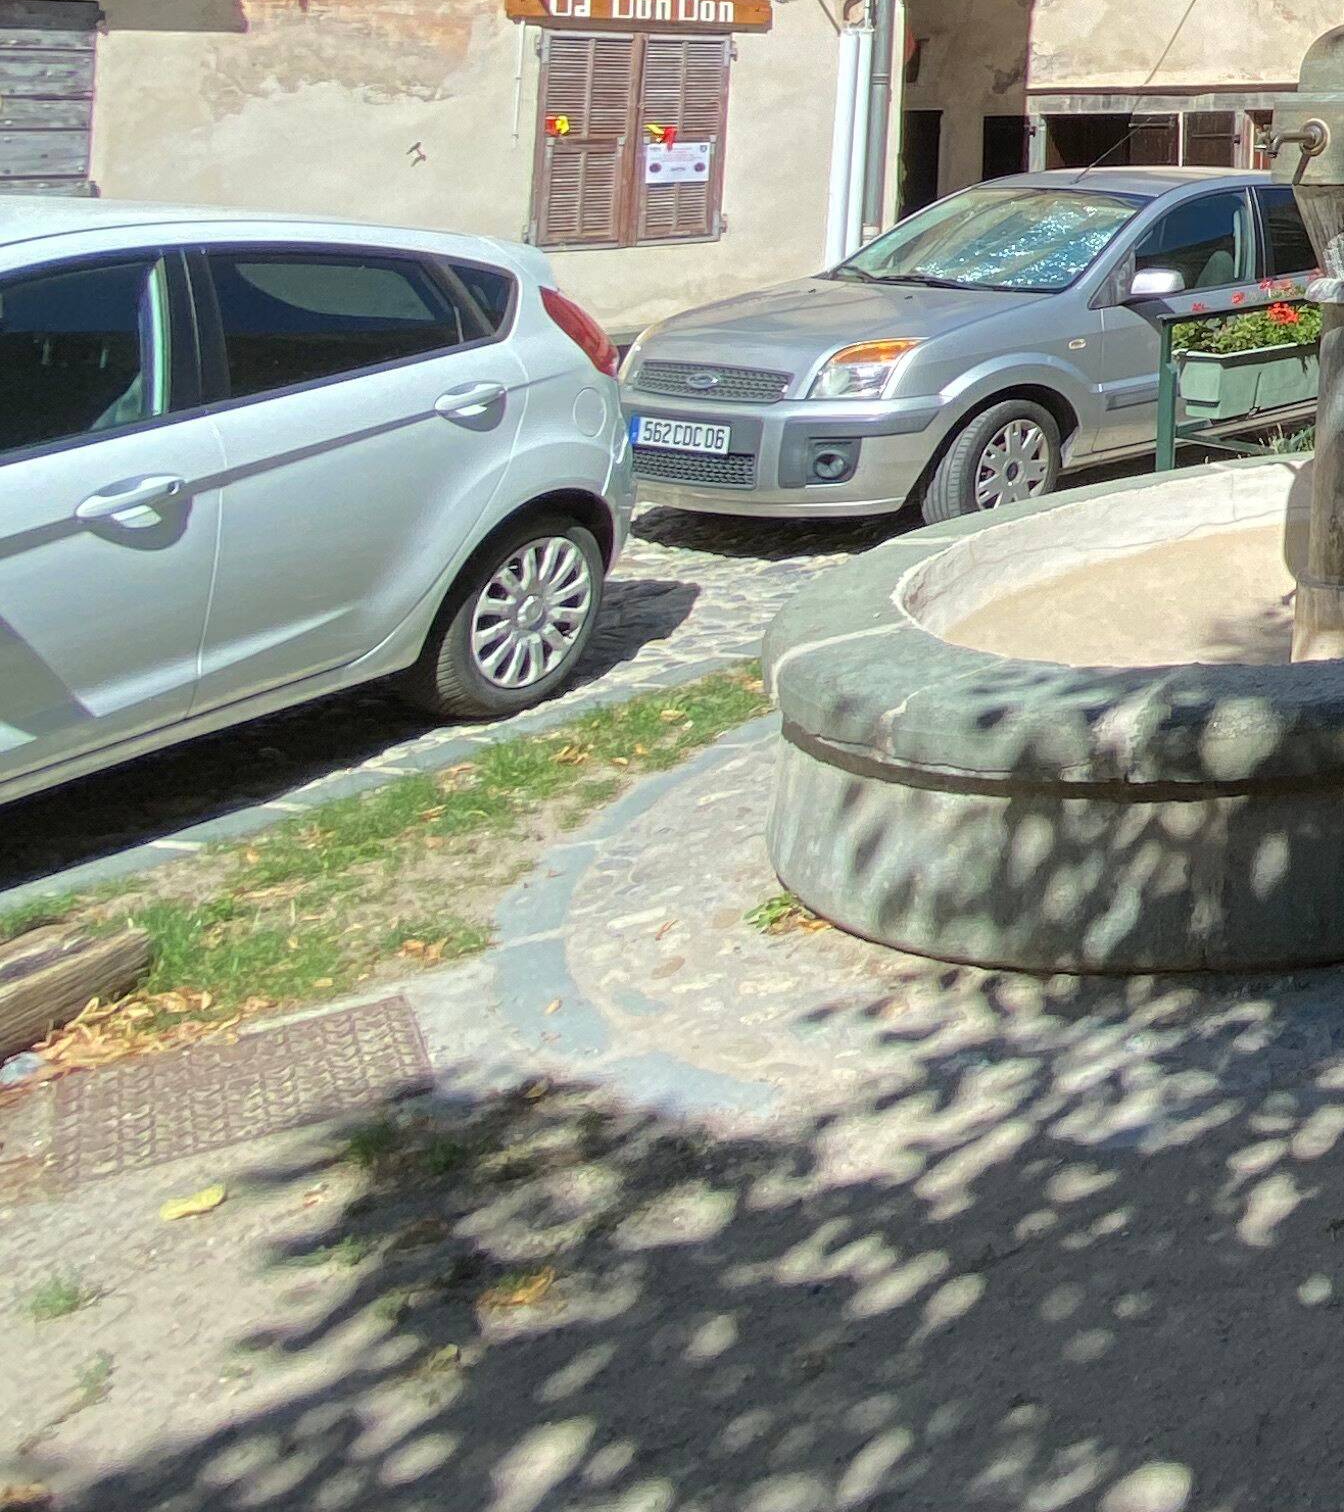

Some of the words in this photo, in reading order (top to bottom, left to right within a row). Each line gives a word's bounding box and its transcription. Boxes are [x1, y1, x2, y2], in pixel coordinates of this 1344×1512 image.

[643, 421, 671, 444] 562
[673, 424, 703, 447] CDC
[705, 428, 725, 450] 06
